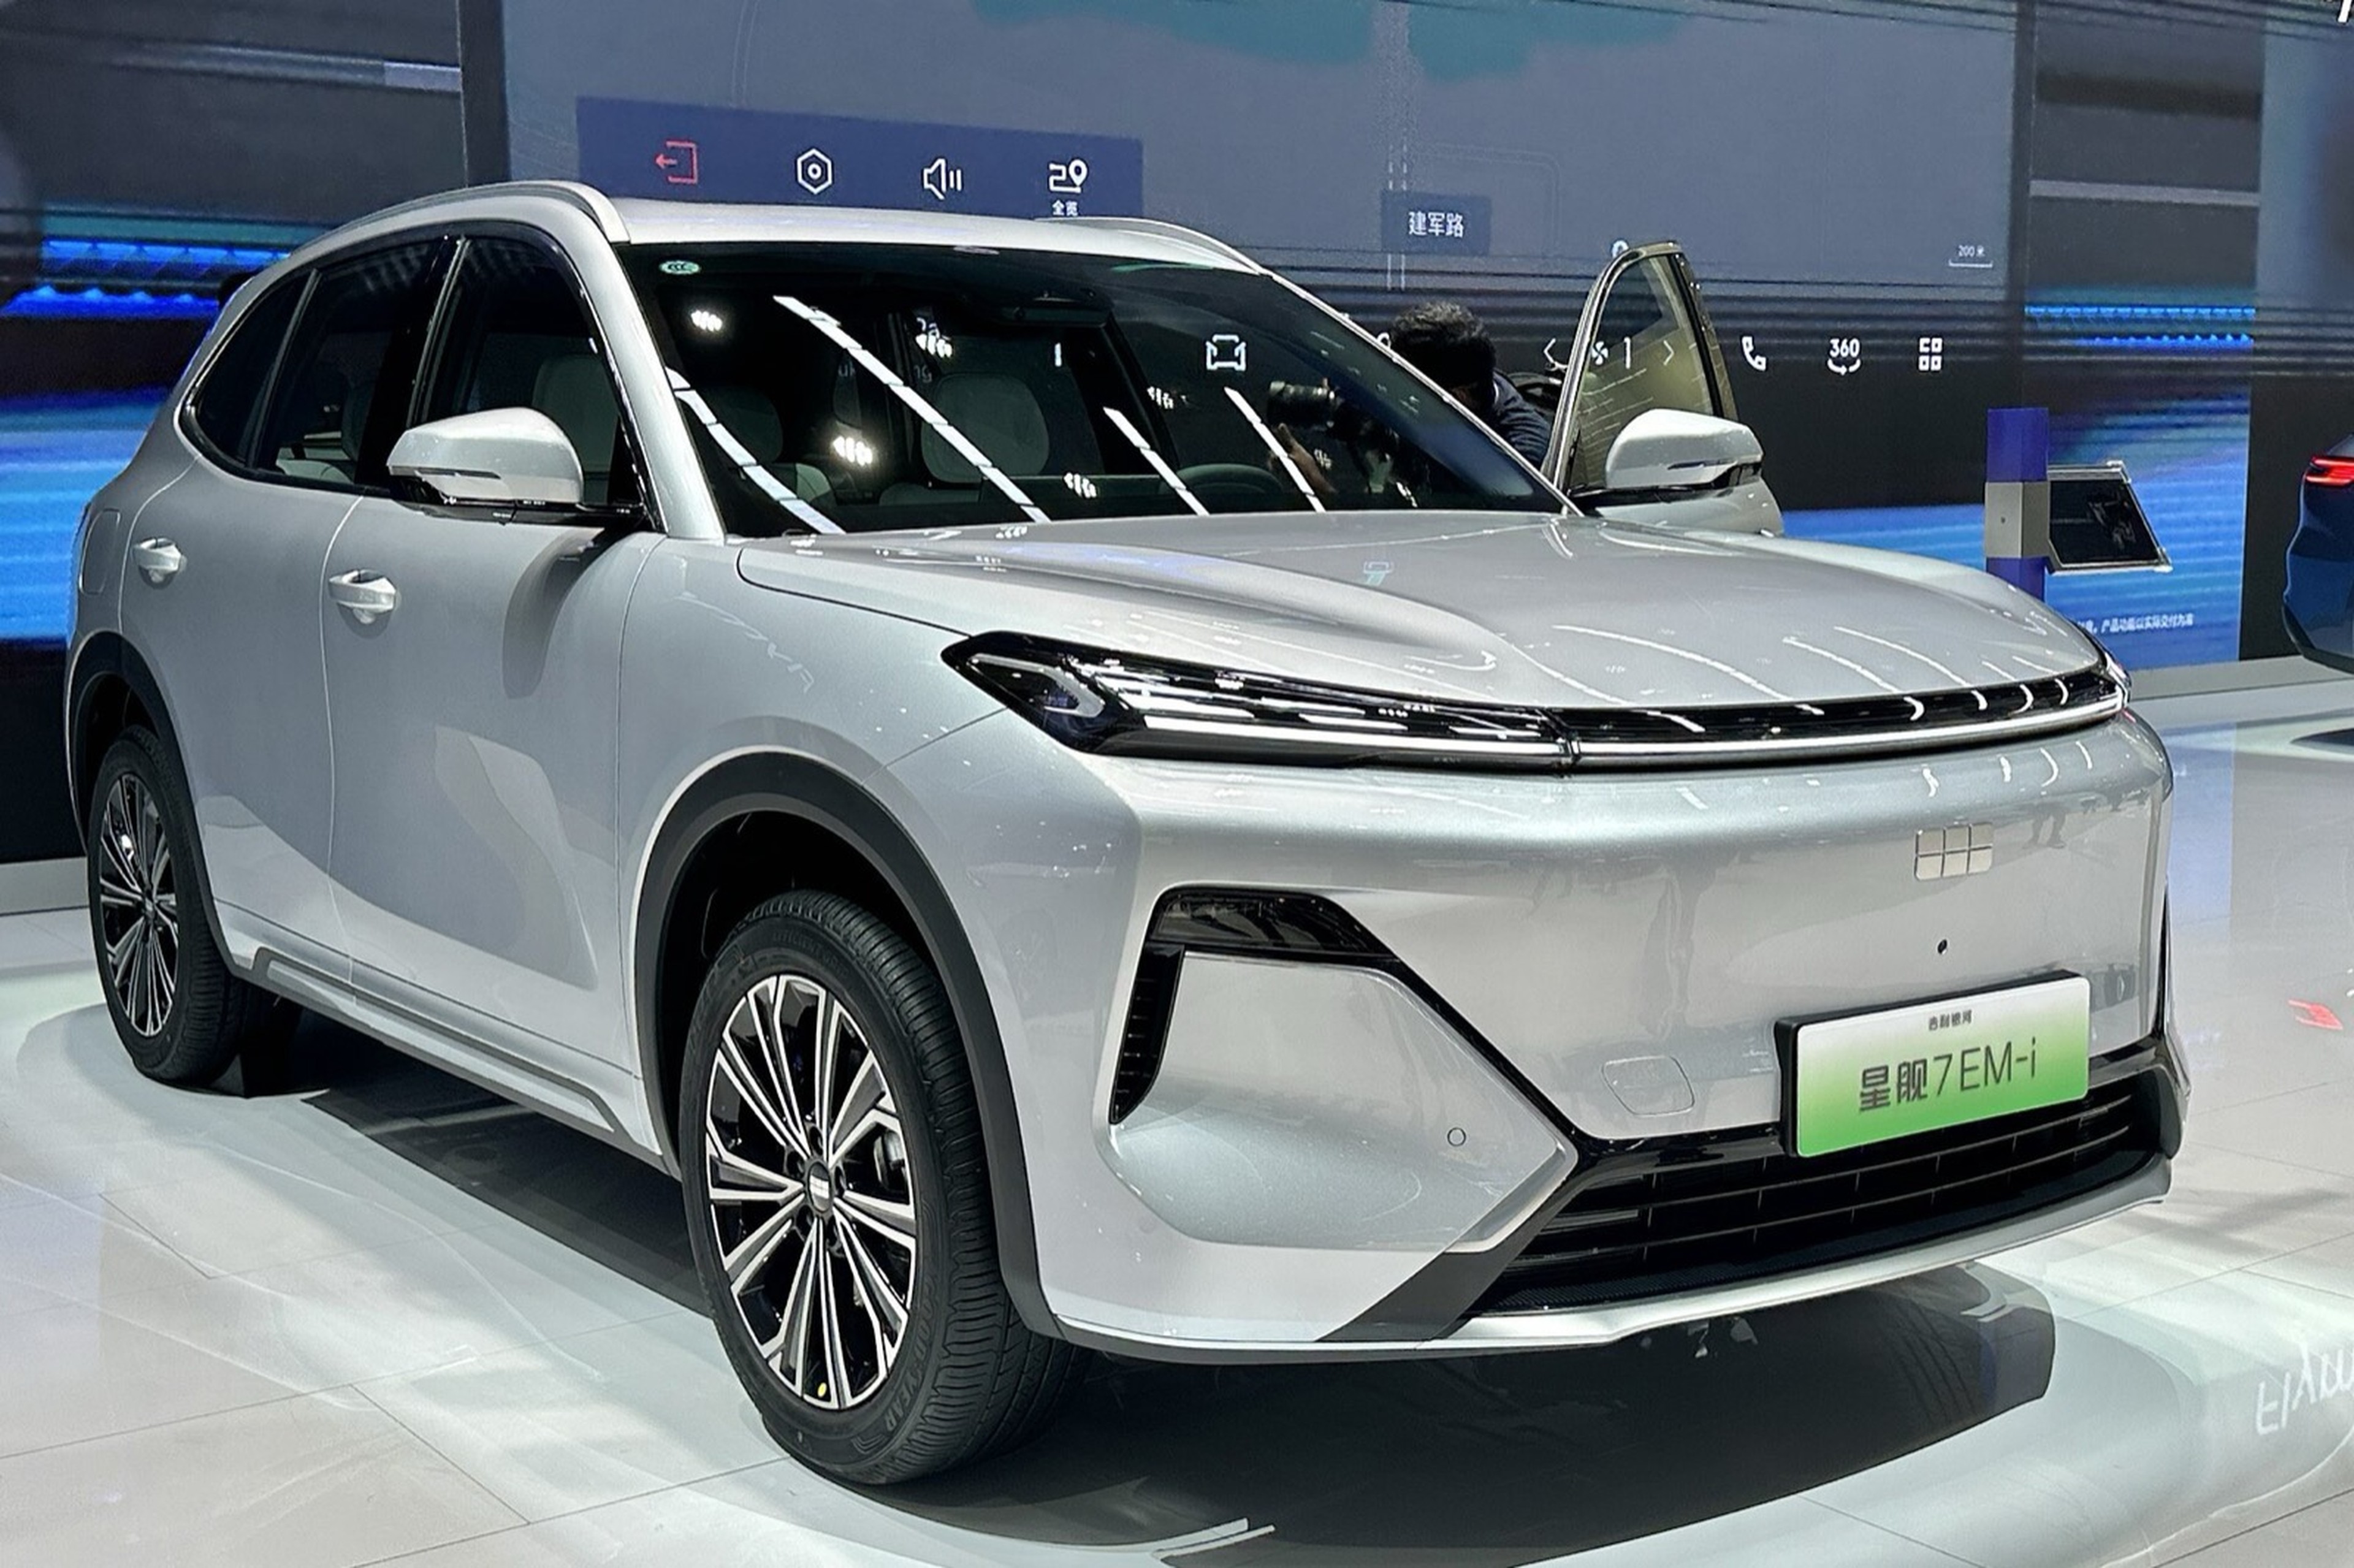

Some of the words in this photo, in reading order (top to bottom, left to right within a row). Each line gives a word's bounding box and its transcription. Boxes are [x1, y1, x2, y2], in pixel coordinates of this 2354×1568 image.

[1407, 211, 1465, 238] 建军路
[1830, 338, 1861, 357] 360
